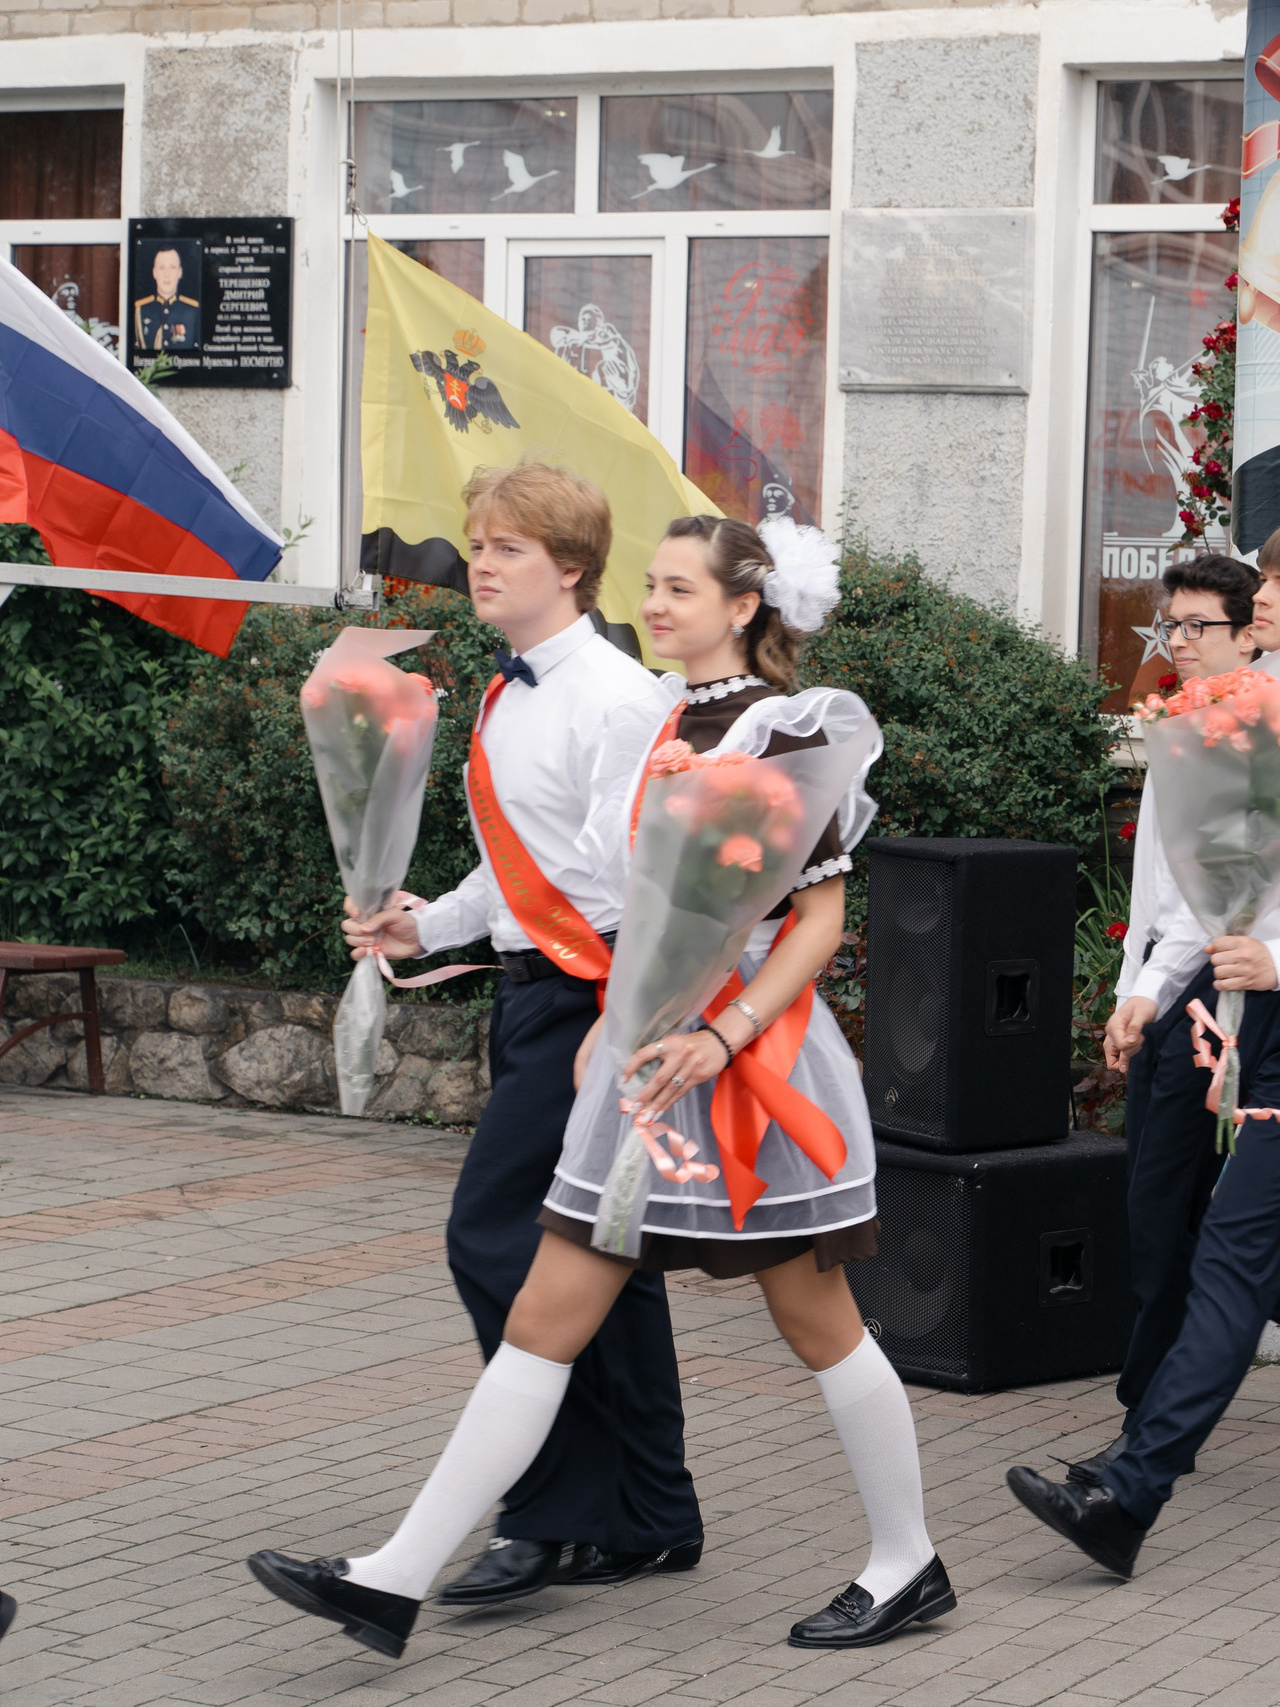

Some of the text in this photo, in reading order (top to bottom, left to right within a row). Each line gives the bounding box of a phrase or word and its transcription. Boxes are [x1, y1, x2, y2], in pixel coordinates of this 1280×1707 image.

[218, 278, 271, 289] ТЕРЕЩЕНКО
[223, 288, 265, 300] ДМИТРИЙ
[219, 301, 268, 311] СЕРГЕЕВИЧ
[240, 353, 285, 367] ПОСМЕРТНО
